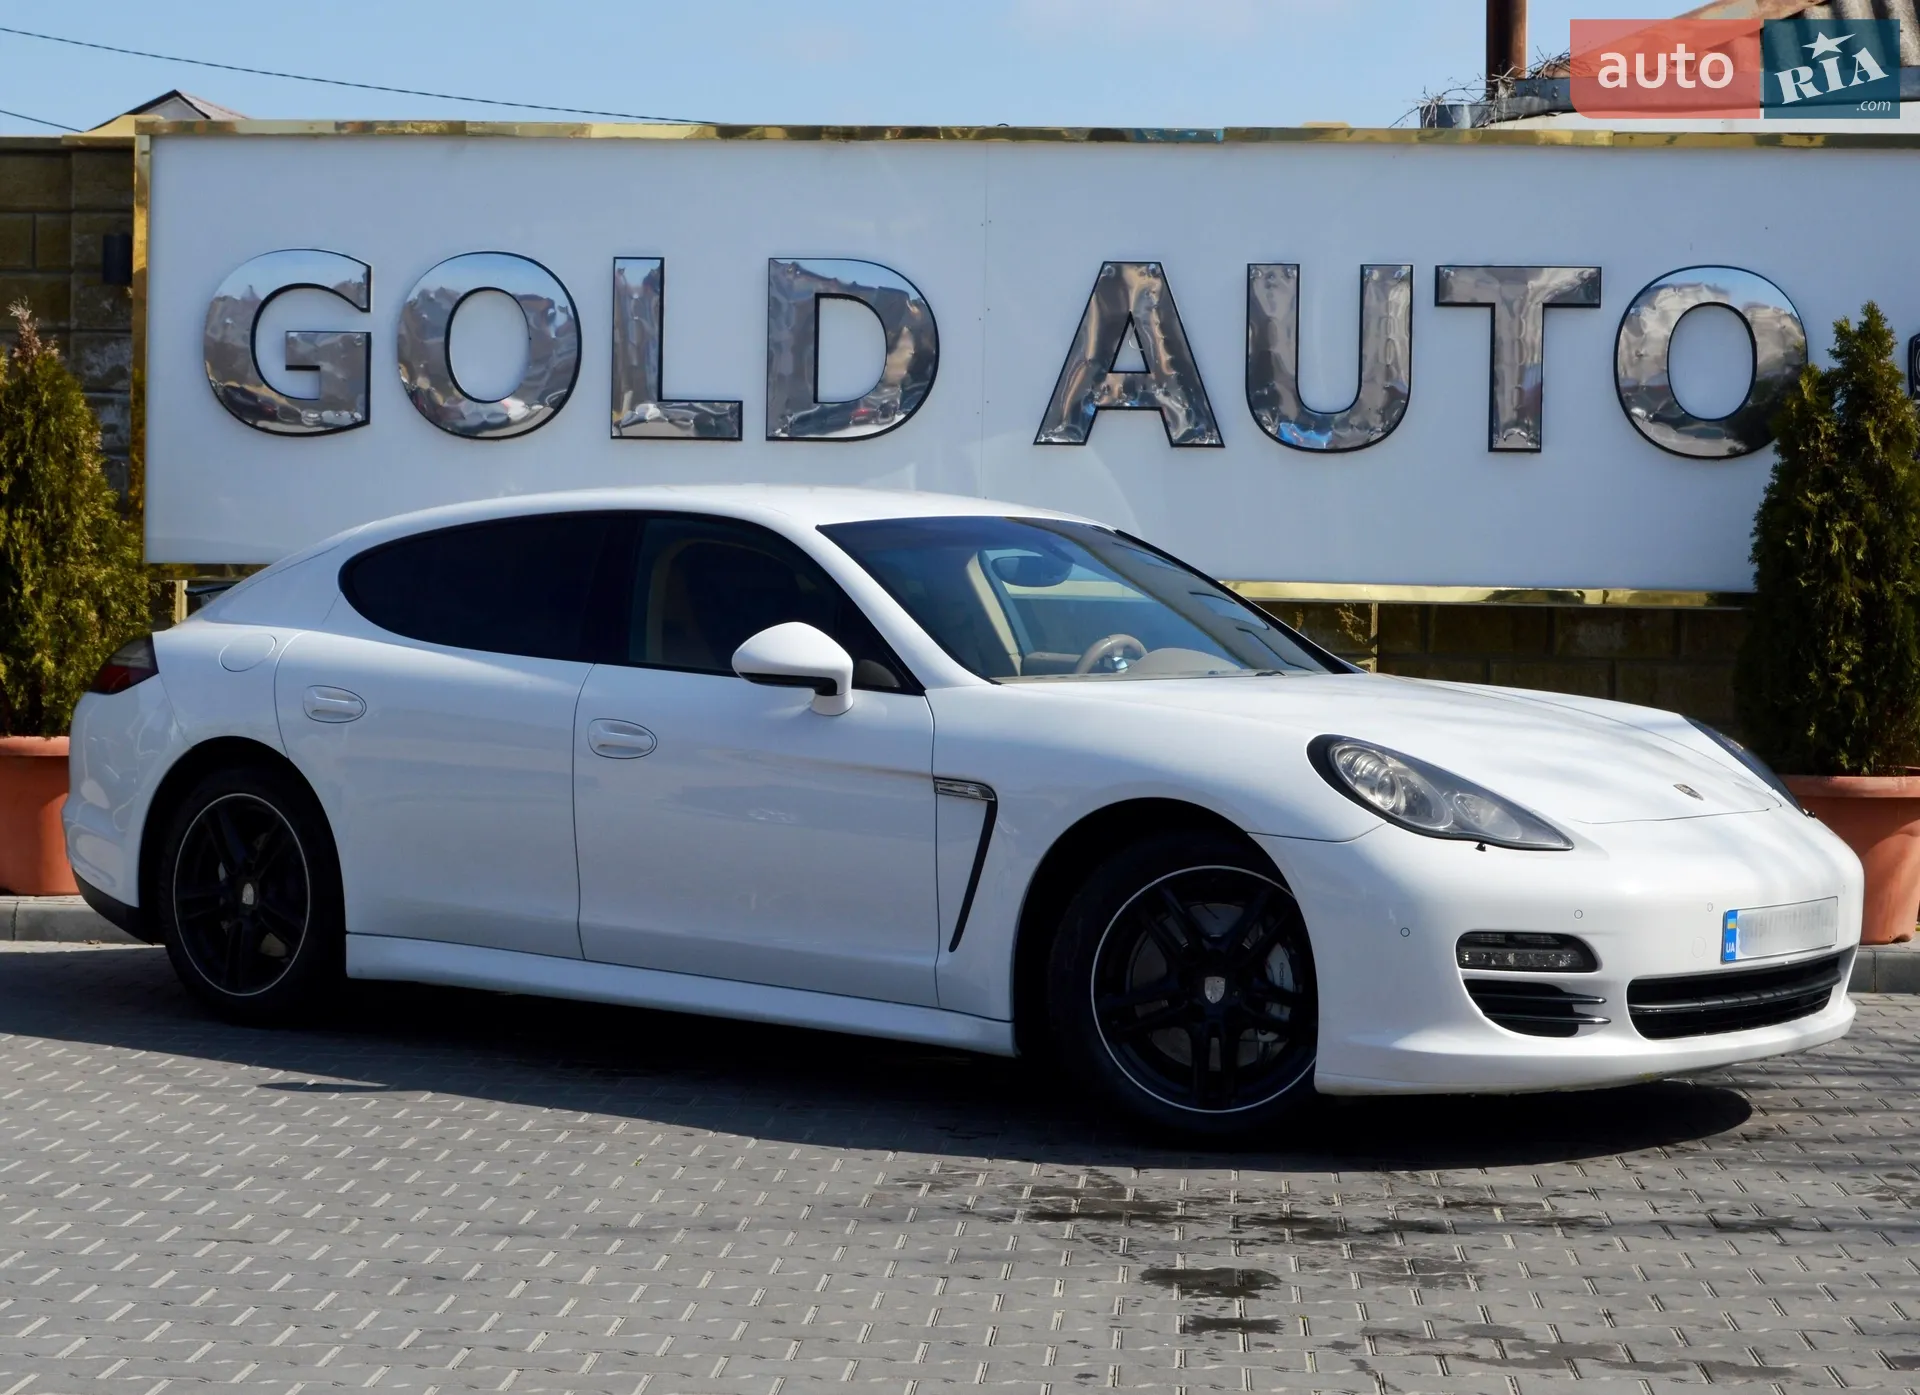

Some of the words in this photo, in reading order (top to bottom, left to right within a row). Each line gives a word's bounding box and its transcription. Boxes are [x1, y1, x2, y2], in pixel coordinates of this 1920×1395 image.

[203, 248, 940, 441] GOLD
[1033, 260, 1808, 459] AUTO
[1725, 942, 1735, 953] UA
